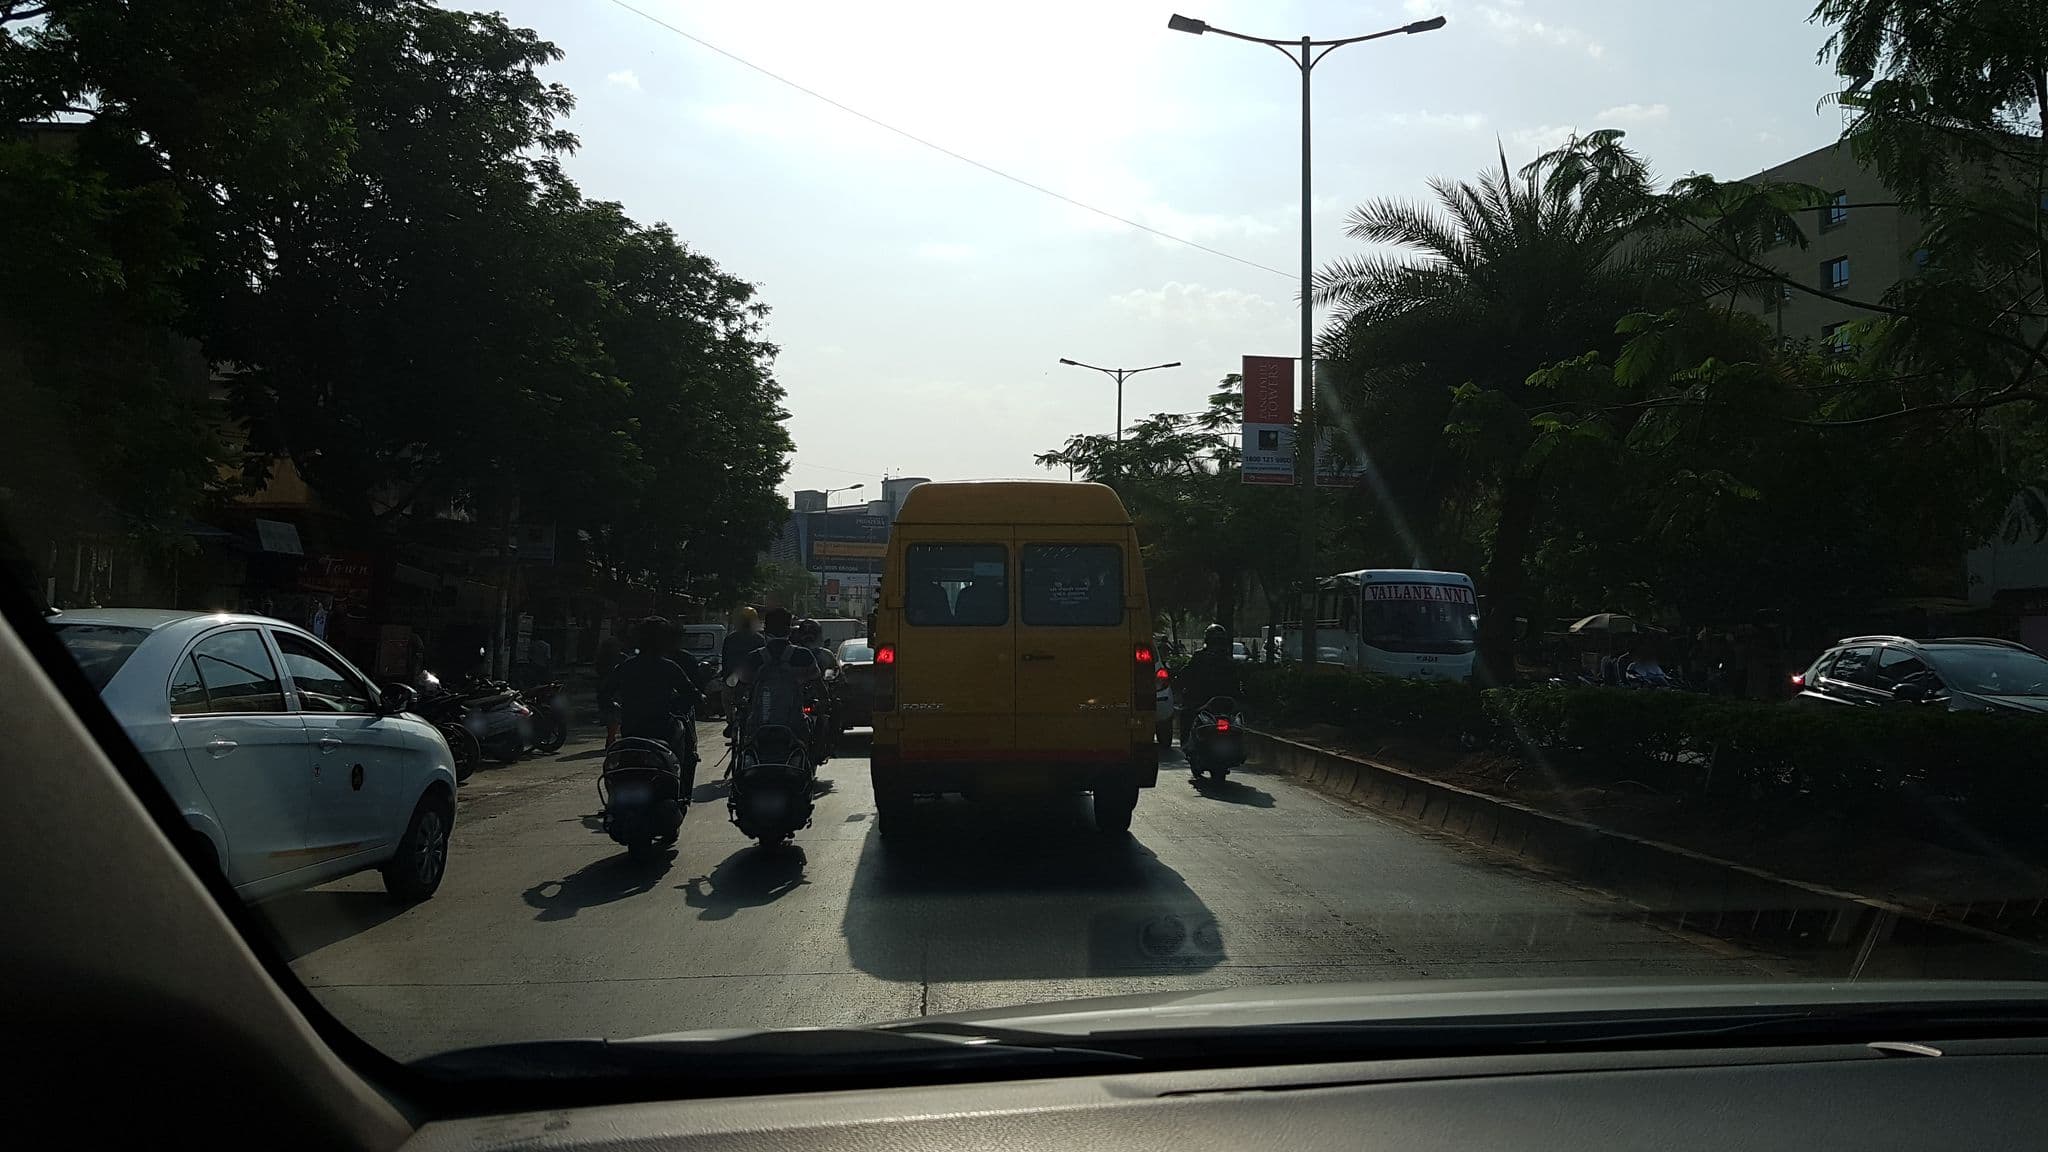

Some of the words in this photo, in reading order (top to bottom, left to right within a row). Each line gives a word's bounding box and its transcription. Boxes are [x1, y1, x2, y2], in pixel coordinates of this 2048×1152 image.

[1267, 361, 1279, 419] TOWERS
[1369, 585, 1468, 603] VAILANKANNI
[901, 703, 944, 711] FORCE
